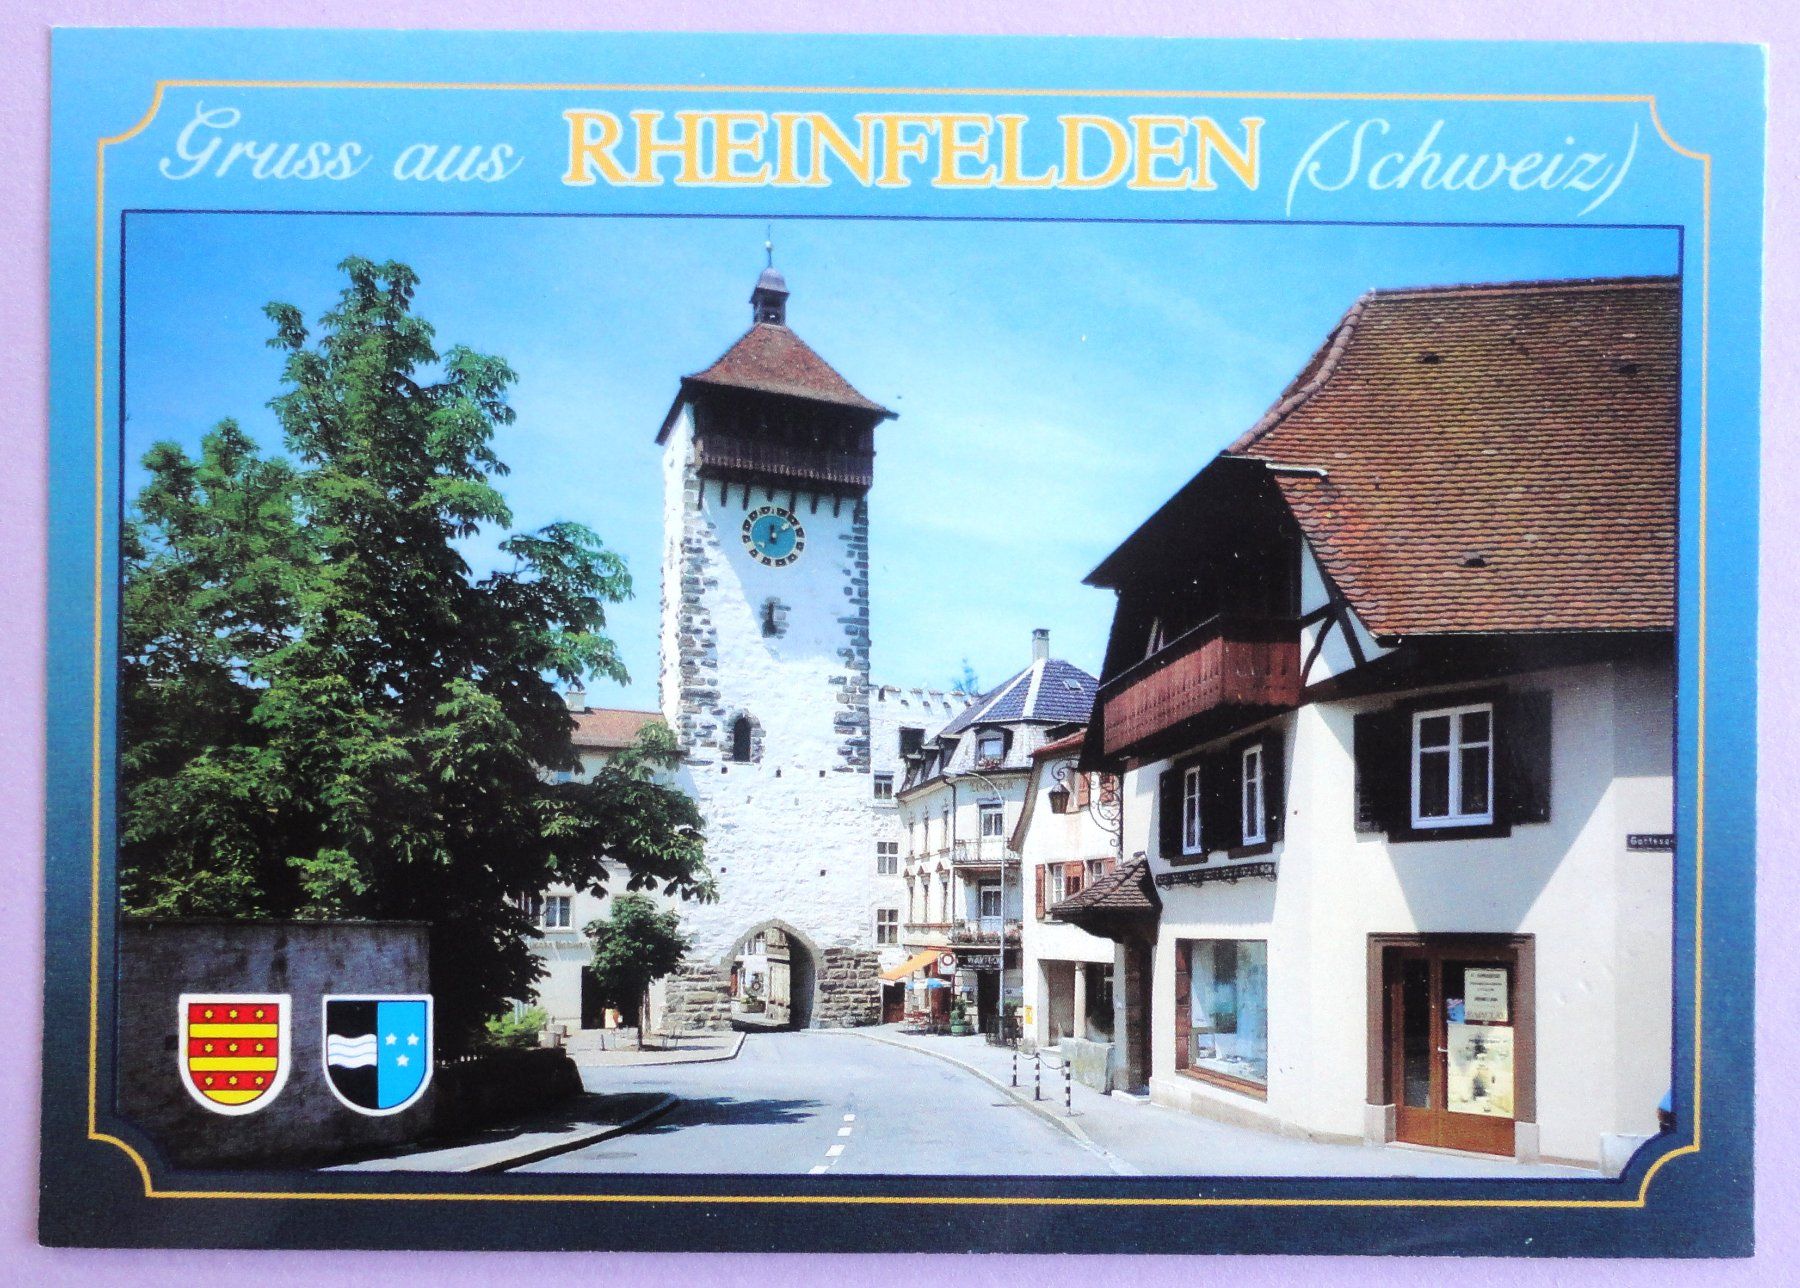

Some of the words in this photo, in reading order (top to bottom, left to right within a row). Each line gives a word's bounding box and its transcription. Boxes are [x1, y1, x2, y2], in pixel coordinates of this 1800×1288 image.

[157, 100, 374, 183] Gruss
[391, 141, 525, 183] aus
[560, 107, 1266, 190] RHEINFELDEN
[1284, 117, 1641, 218] (Schweiz)
